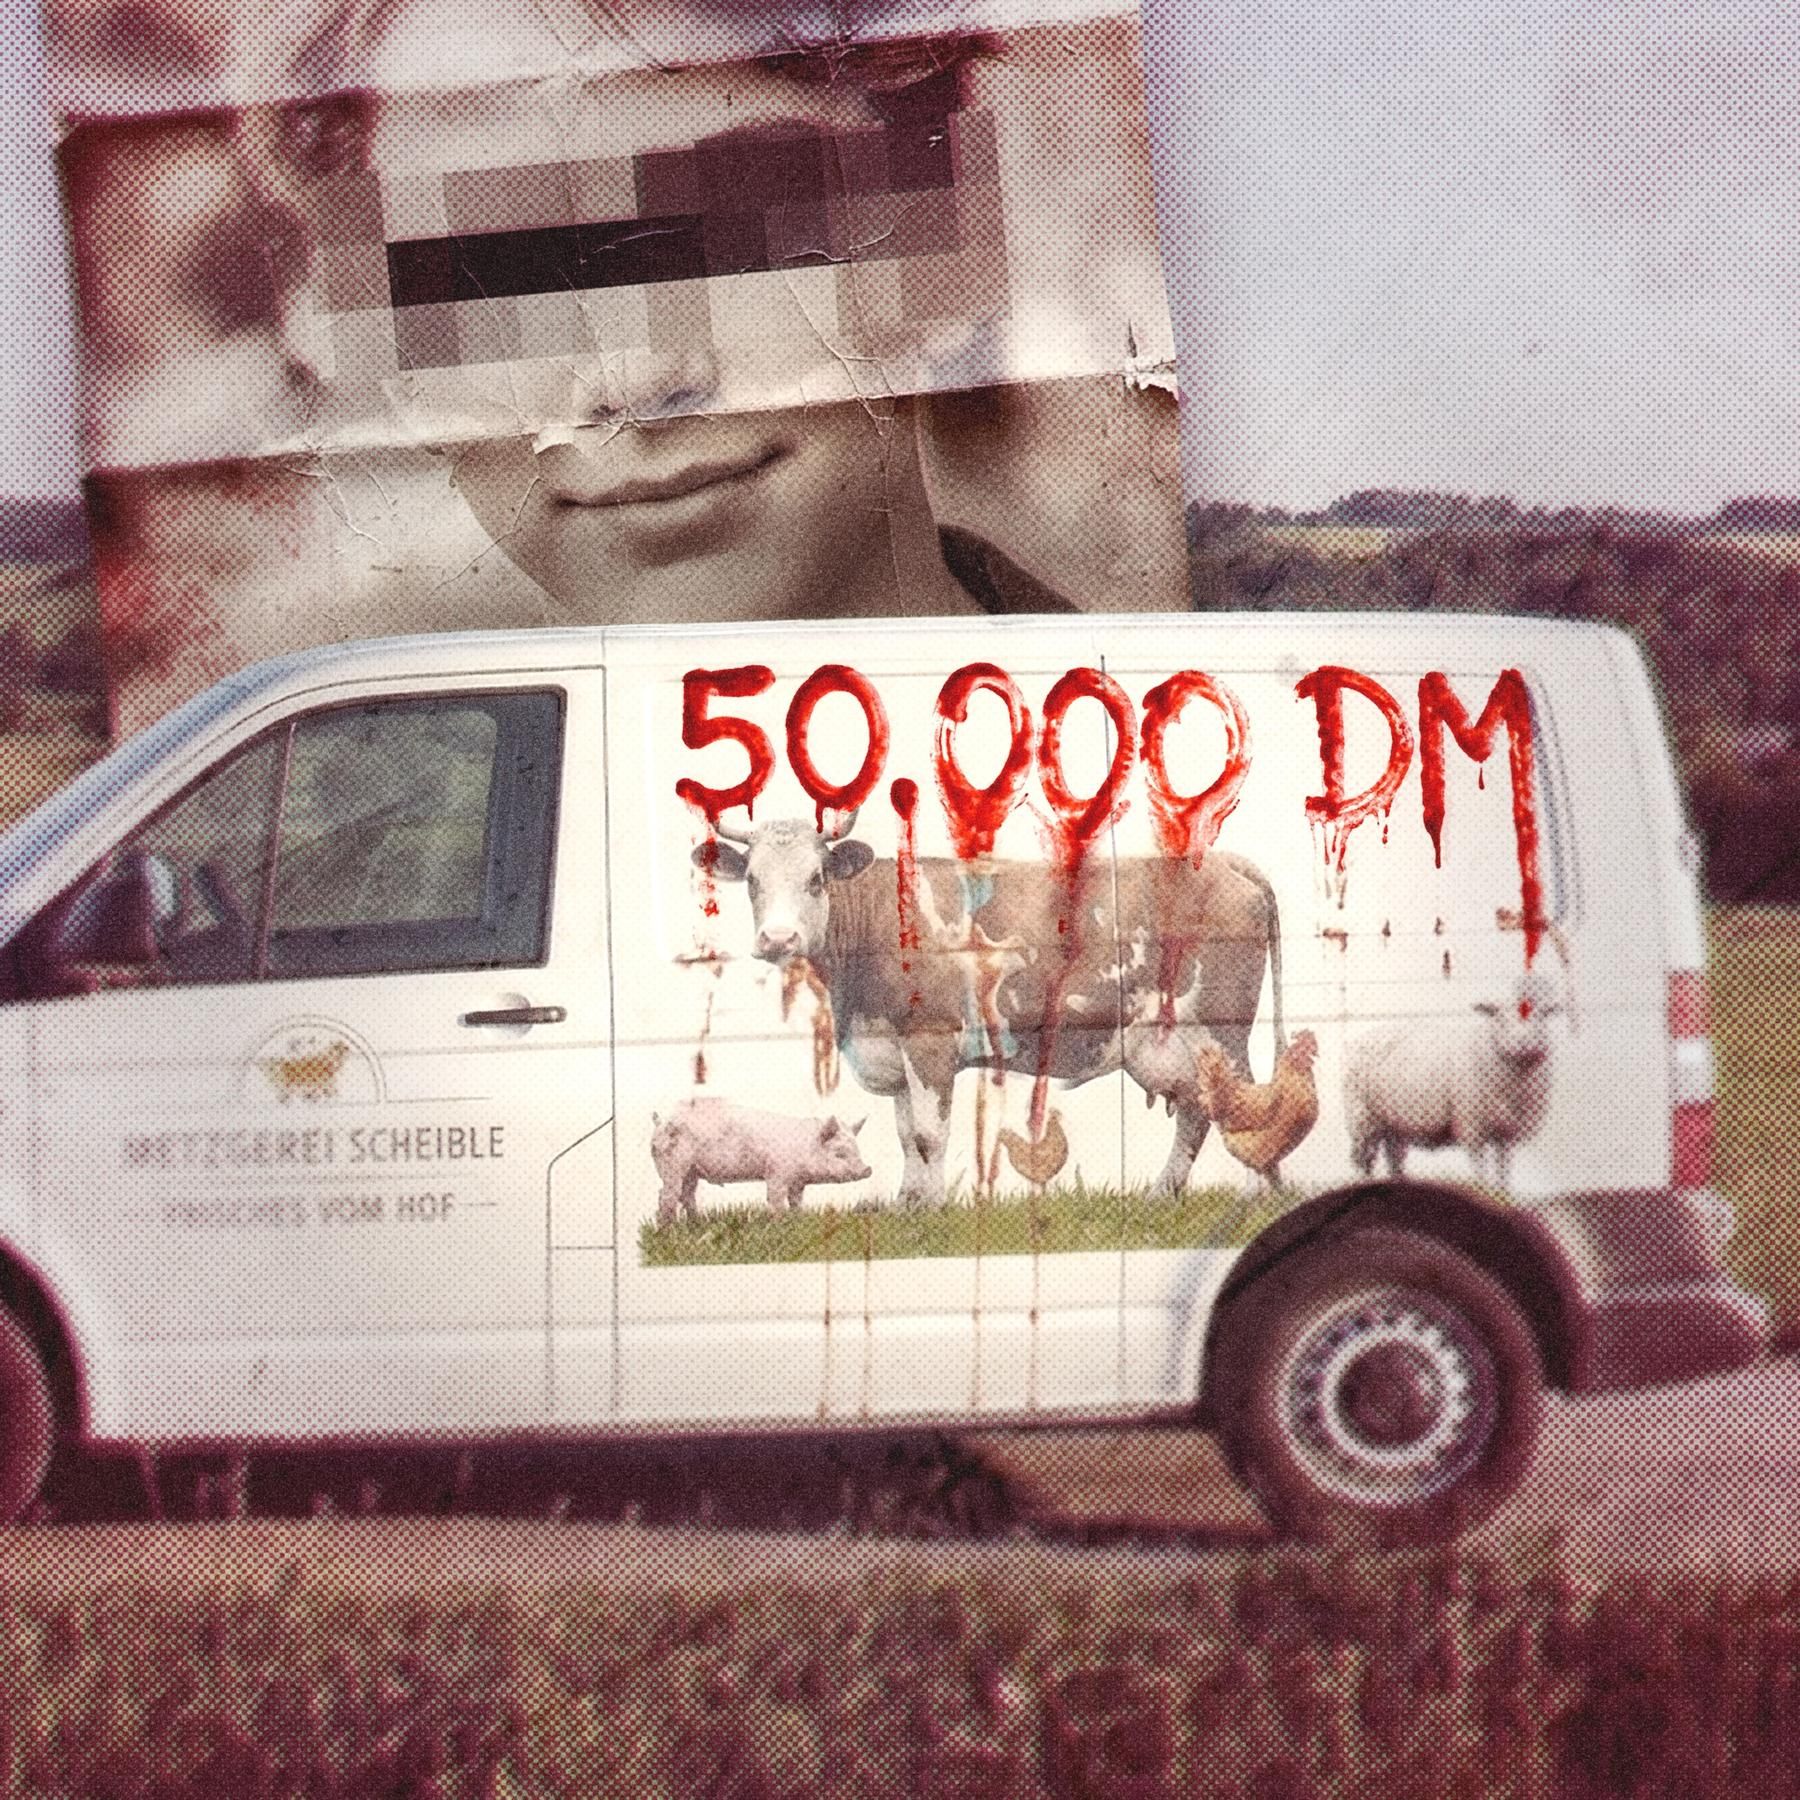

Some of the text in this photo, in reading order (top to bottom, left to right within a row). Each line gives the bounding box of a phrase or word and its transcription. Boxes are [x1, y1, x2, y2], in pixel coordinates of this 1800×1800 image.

[676, 662, 1538, 860] 50.000 DM
[123, 1126, 504, 1169] METZGEREI SCHEIBLE
[318, 1194, 383, 1225] VOM
[396, 1192, 456, 1222] HOF
